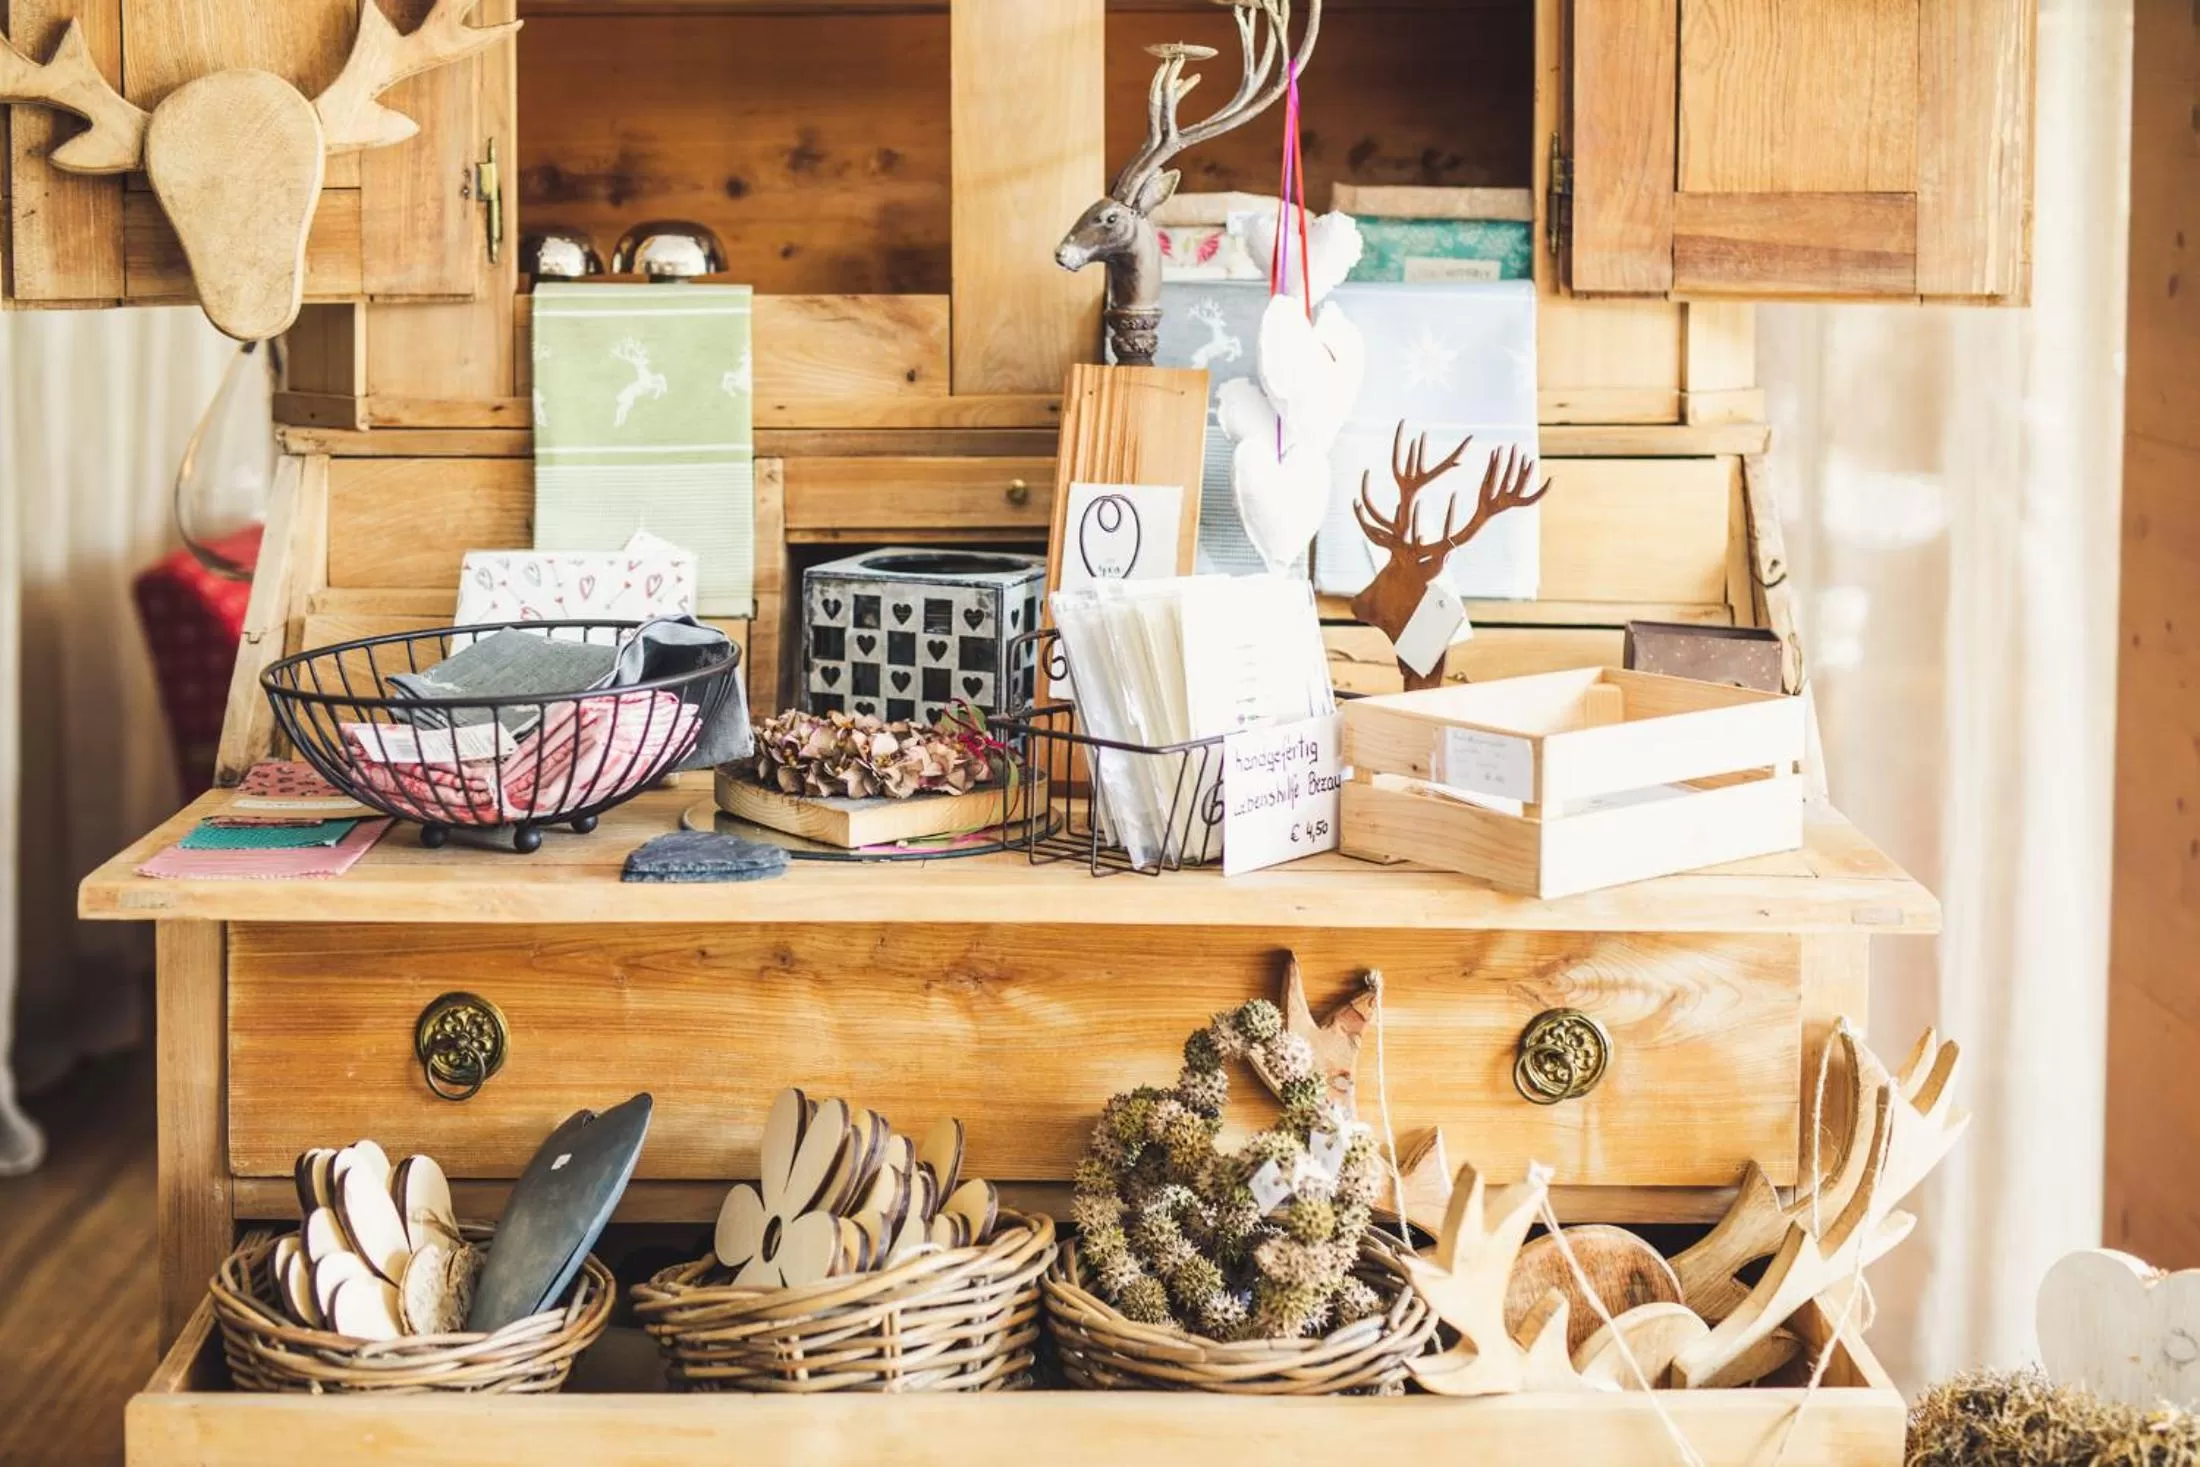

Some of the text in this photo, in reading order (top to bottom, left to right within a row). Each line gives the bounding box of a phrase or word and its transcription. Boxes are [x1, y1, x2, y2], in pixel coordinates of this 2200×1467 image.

[1308, 770, 1341, 796] Bezau
[1290, 819, 1329, 843] € 4,50
